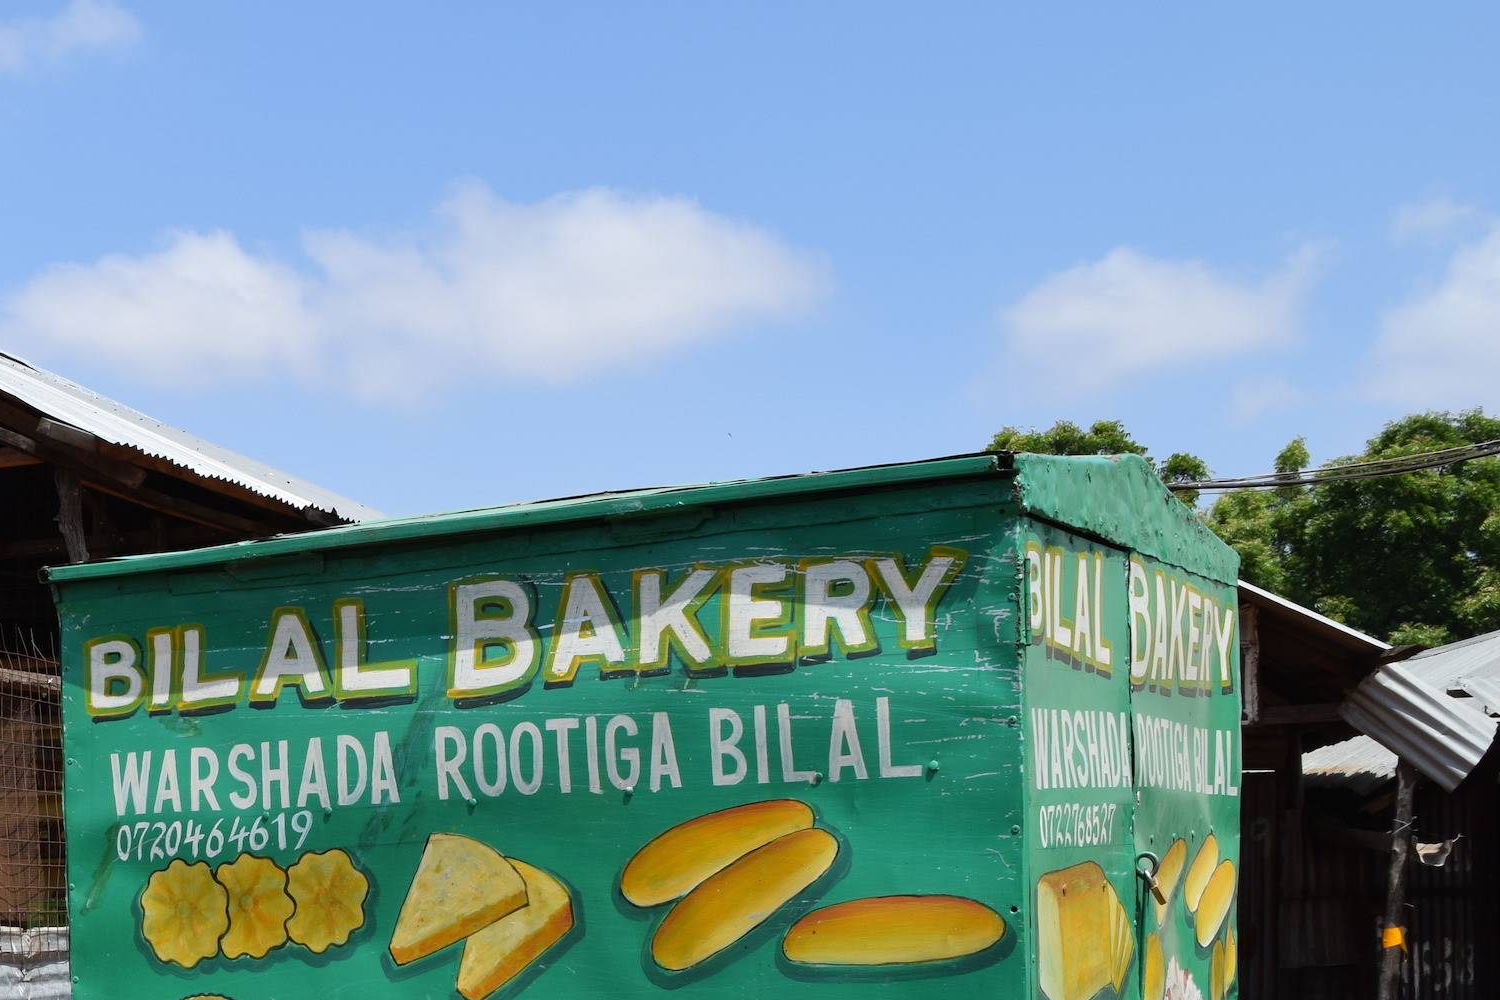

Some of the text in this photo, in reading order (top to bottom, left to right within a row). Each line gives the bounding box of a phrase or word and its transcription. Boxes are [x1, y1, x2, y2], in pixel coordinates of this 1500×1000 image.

[85, 546, 968, 718] BILAL BAKERY
[1027, 541, 1234, 693] BILAL BAKERY
[110, 697, 923, 816] WARSHADA ROOTIGA BILAL
[1031, 708, 1238, 796] WARSHADA ROOTIGA BILAL
[116, 810, 314, 862] 0720464619
[1040, 803, 1117, 848] 0722768527
